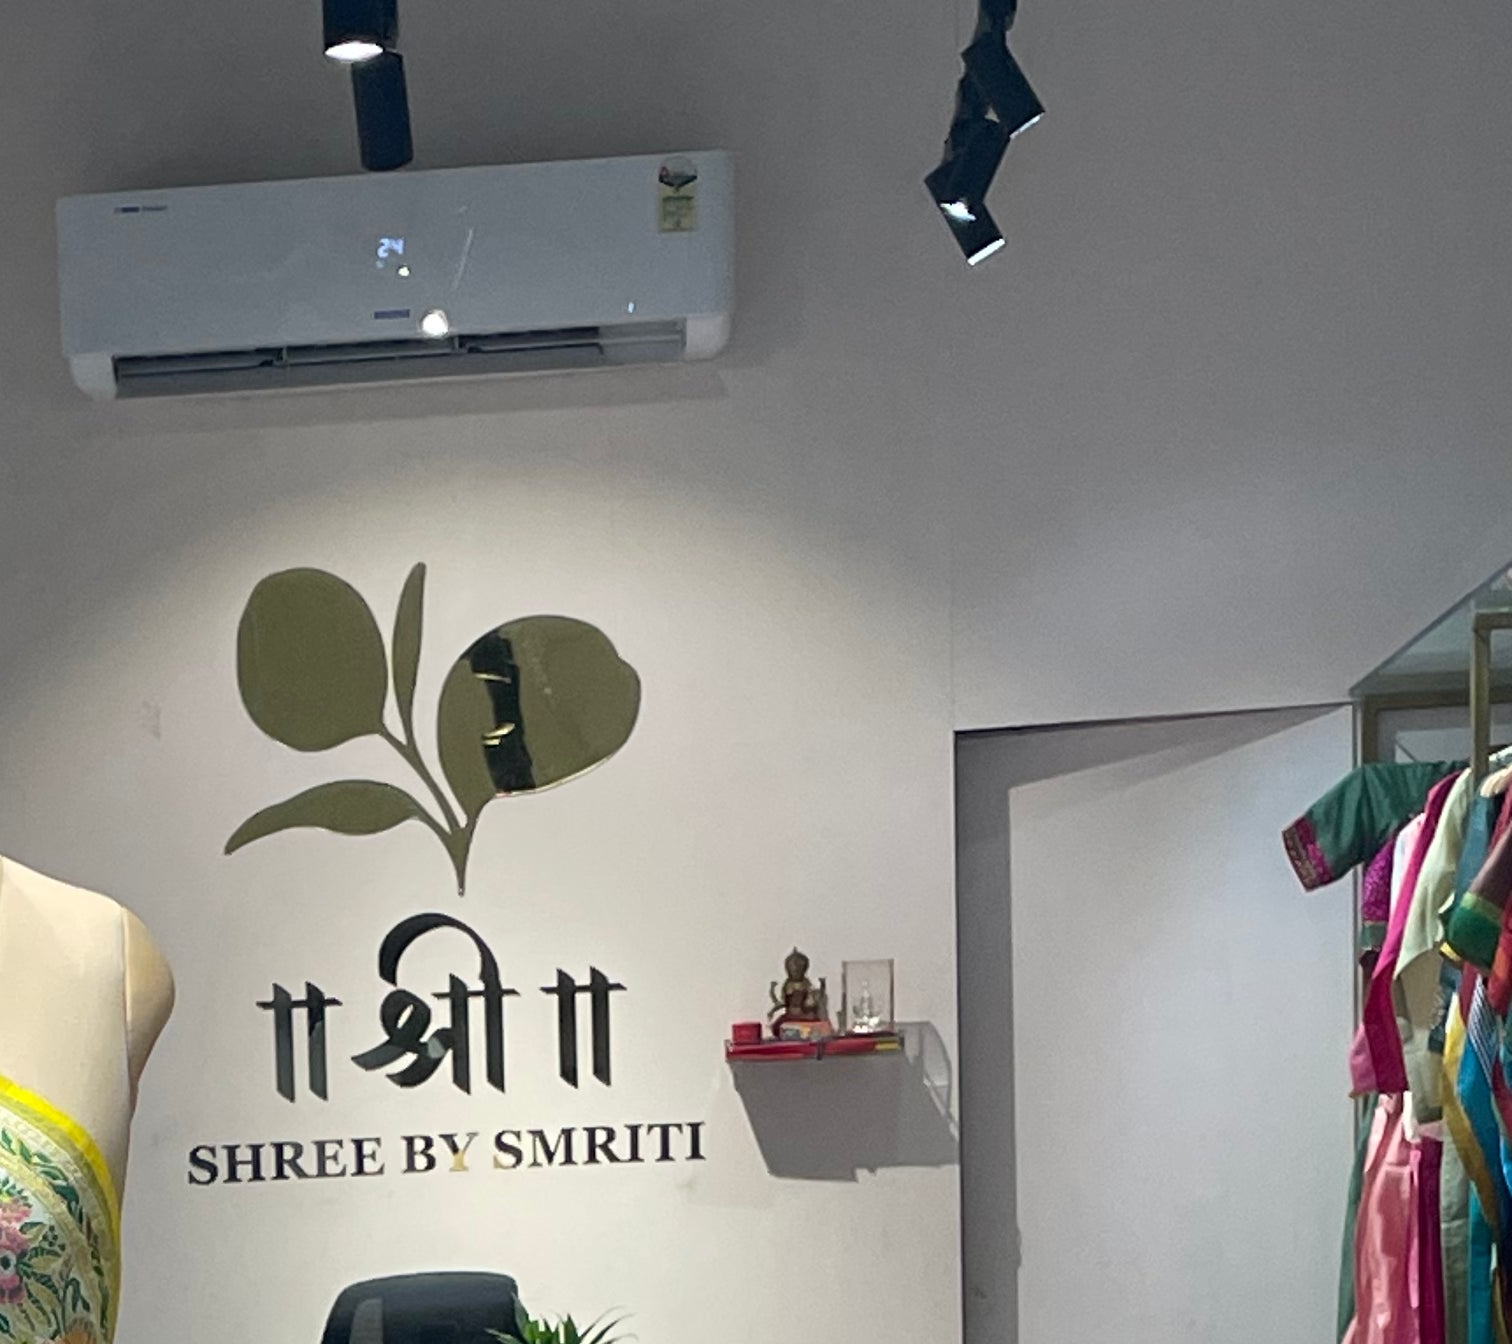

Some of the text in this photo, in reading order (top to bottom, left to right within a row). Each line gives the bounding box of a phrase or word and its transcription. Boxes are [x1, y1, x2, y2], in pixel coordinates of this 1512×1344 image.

[350, 912, 521, 1095] श्री
[187, 1121, 707, 1186] SHREE BY SMRITI
